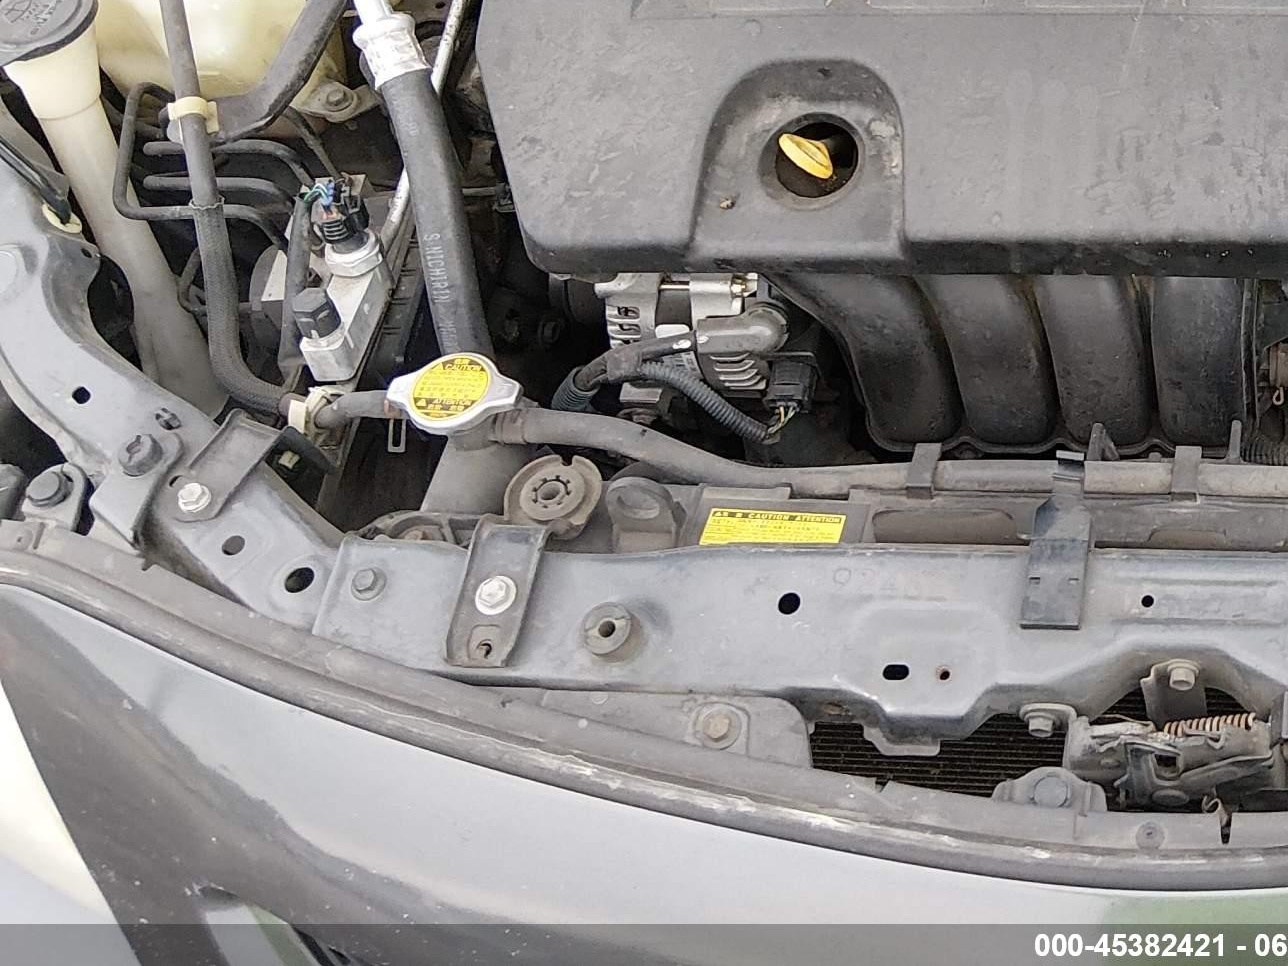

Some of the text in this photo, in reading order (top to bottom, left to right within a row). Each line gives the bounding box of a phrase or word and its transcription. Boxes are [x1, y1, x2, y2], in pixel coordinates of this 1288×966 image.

[445, 363, 482, 372] CAUTION
[748, 513, 789, 521] CAUTION
[794, 515, 841, 524] ATTENTION
